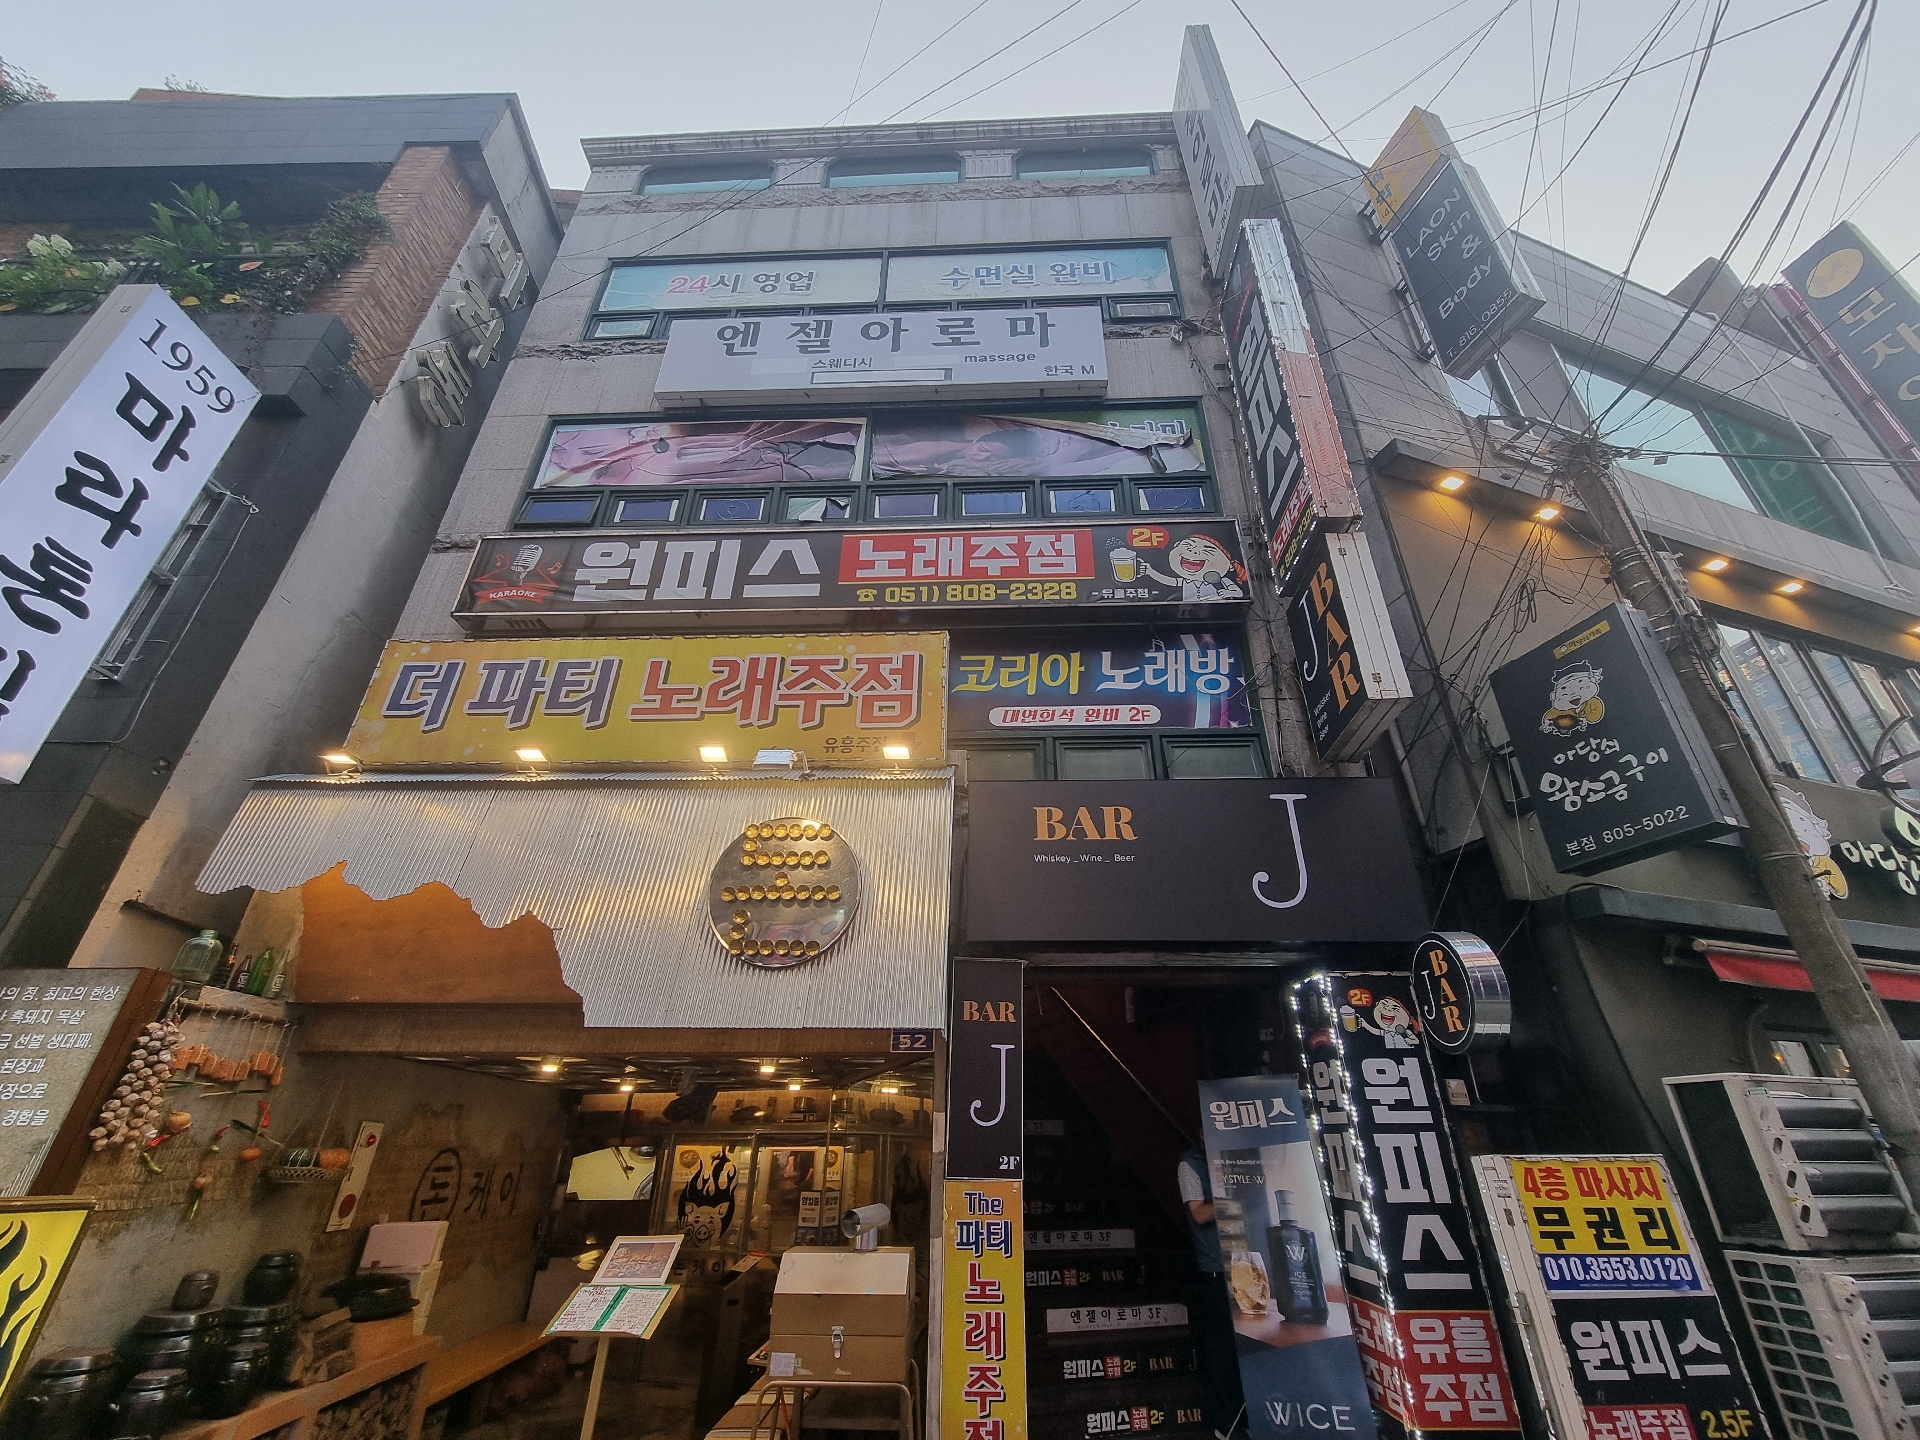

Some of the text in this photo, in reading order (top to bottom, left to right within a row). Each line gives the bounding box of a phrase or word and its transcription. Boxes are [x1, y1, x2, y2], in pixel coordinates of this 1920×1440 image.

[1405, 187, 1461, 260] LAON
[1427, 210, 1471, 262] Skin
[1461, 233, 1482, 260] &
[667, 270, 815, 295] 24시 영업
[940, 260, 1114, 289] 수면실 완비
[1438, 253, 1492, 321] Body
[716, 312, 1055, 358] 엔젤아로마
[138, 318, 237, 416] 1959
[812, 351, 1037, 369] 스웨디시 massage
[1044, 364, 1096, 377] 한국 M
[1238, 294, 1299, 520] 원피스
[0, 371, 198, 724] 마라톤
[1132, 526, 1165, 547] 2F
[573, 533, 1077, 604] 원피스 노래주점
[489, 588, 538, 600] KARAOKE
[884, 582, 1078, 603] 051) 808-2328
[1298, 589, 1319, 682] J
[1310, 561, 1361, 715] BAR
[951, 647, 1235, 695] 코리아 노래방
[382, 651, 924, 732] 더 파티 노래주점
[1001, 706, 1151, 724] 대연회석 완비 2F
[1539, 747, 1670, 812] 왕소금구이
[1033, 806, 1138, 840] BAR
[1565, 805, 1691, 857] 본점 805-5022
[1034, 853, 1136, 863] Whiskey Wine Beer
[1253, 793, 1309, 909] J
[21, 986, 39, 1001] 정.
[42, 985, 88, 1001] 최고의
[89, 985, 121, 1001] 한상
[1349, 988, 1371, 1005] 2F
[1420, 971, 1436, 1021] J
[1430, 950, 1466, 1034] BAR
[9, 1009, 54, 1025] 흑돼지
[56, 1009, 86, 1025] 목살
[962, 1000, 1017, 1023] BAR
[14, 1033, 46, 1049] 선별
[47, 1032, 93, 1049] 생대패.
[898, 1033, 927, 1049] 52
[1, 1058, 47, 1074] 된장과
[0, 1083, 49, 1101] 장으로
[969, 1044, 1016, 1127] J
[1, 1109, 50, 1127] 경험을
[1209, 1095, 1298, 1132] 원피스
[998, 1155, 1020, 1170] 2F
[1313, 1056, 1380, 1289] 원피스
[1362, 1057, 1474, 1291] 원피스
[1228, 1174, 1251, 1184] STYLE
[1522, 1166, 1570, 1202] 4층
[1572, 1166, 1663, 1202] 마사지
[963, 1190, 1004, 1215] The
[954, 1218, 1013, 1257] 파티
[1532, 1205, 1682, 1251] 무권리
[1025, 1269, 1062, 1287] 원피스
[1079, 1271, 1091, 1283] 2F
[1102, 1270, 1124, 1283] BAR
[1294, 1271, 1308, 1279] ICE
[1544, 1256, 1694, 1282] 010.3553.0120
[1070, 1307, 1142, 1324] 엔젤아로마
[1409, 1317, 1488, 1364] 유흥
[1570, 1318, 1732, 1381] 원피스
[1063, 1358, 1105, 1380] 원피스
[1123, 1359, 1137, 1373] 2F
[1149, 1356, 1174, 1371] BAR
[1422, 1372, 1508, 1423] 주점
[1086, 1409, 1131, 1434] 원피스
[1150, 1410, 1165, 1425] 2F
[1176, 1407, 1202, 1424] BAR
[1265, 1400, 1356, 1432] WICE
[1588, 1408, 1754, 1440] 노래주점 2.5F
